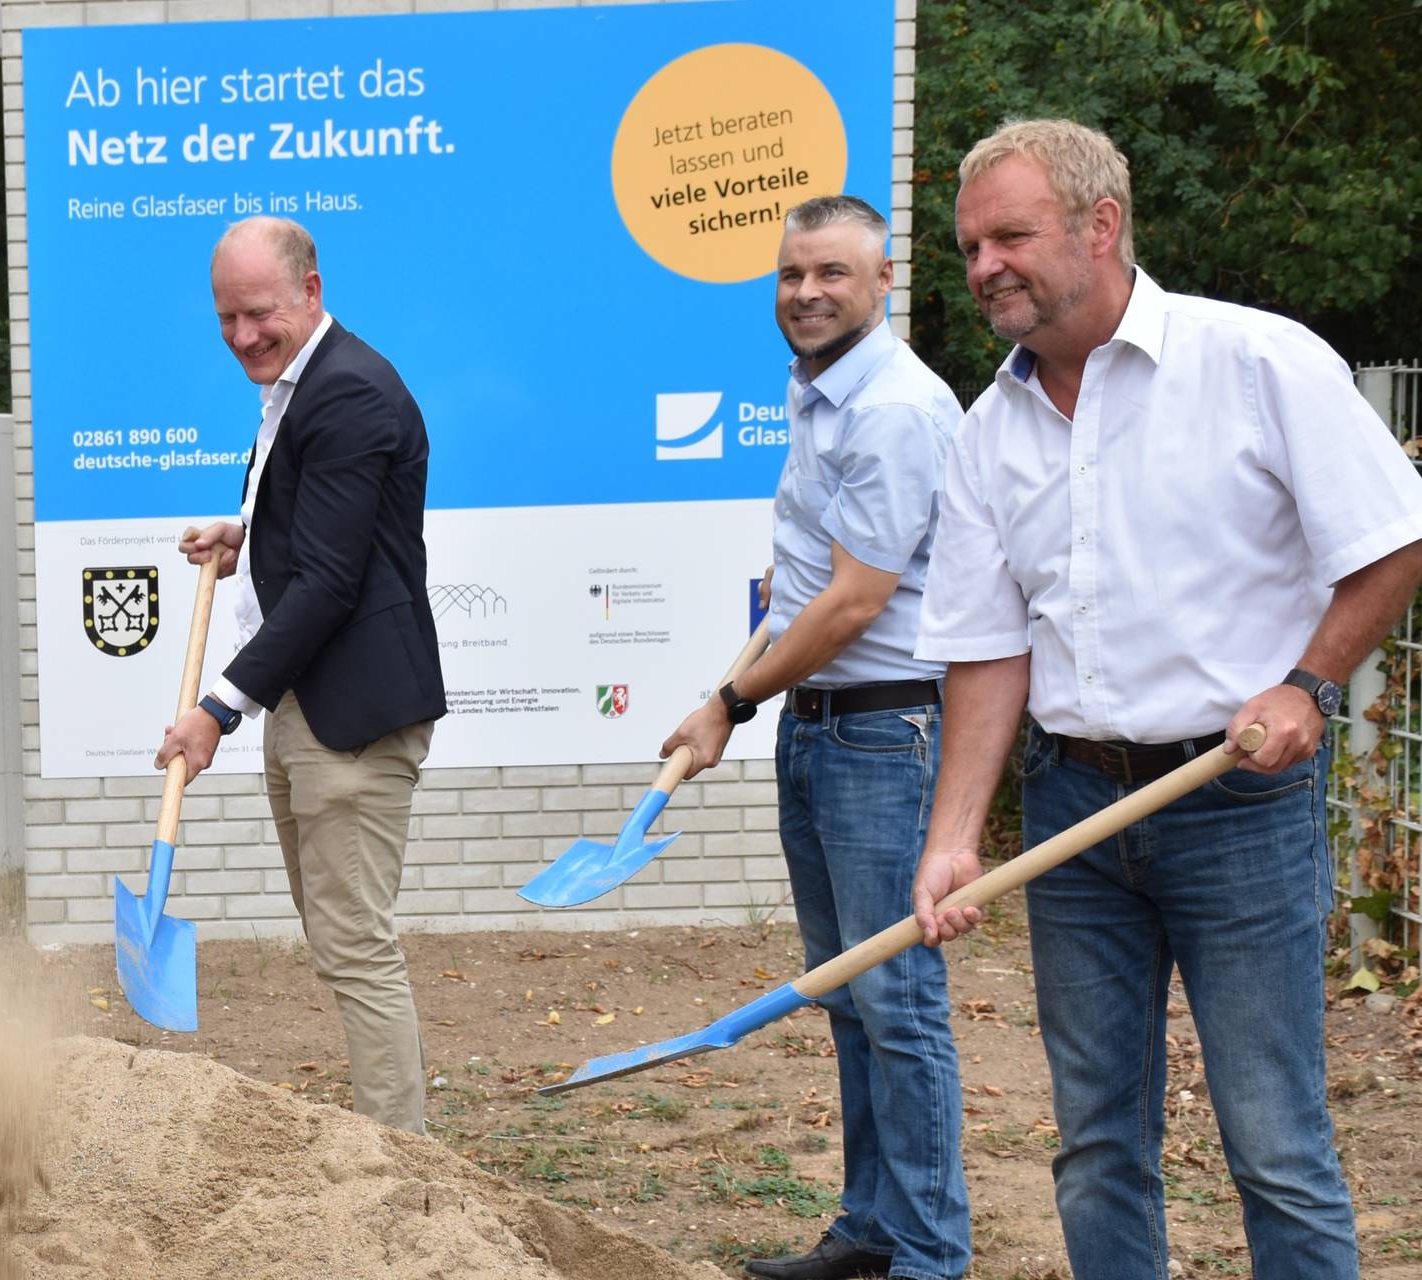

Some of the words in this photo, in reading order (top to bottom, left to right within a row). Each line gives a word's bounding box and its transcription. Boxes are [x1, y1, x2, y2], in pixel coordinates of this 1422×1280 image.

[66, 68, 120, 108] Ab
[137, 66, 207, 106] hier
[220, 65, 345, 104] startet
[359, 58, 425, 98] das
[652, 121, 703, 147] Jetzt
[710, 108, 793, 137] beraten
[68, 128, 168, 166] Netz
[182, 123, 255, 163] der
[269, 115, 455, 160] Zukunft.
[669, 150, 734, 176] lassen
[742, 136, 785, 164] und
[650, 183, 707, 209] viele
[714, 166, 809, 199] Vorteile
[68, 198, 125, 219] Reine
[132, 194, 227, 218] Glasfaser
[234, 192, 263, 214] bis
[270, 191, 298, 213] ins
[306, 190, 363, 212] Haus.
[689, 201, 781, 235] sichern!
[738, 402, 789, 422] Deu
[73, 430, 123, 447] 02861
[129, 428, 161, 446] 890
[165, 427, 198, 444] 600
[738, 425, 792, 446] Glas
[80, 536, 96, 546] Das
[98, 534, 155, 546] Förderprojekt
[156, 535, 176, 544] wird
[462, 638, 508, 648] Breitband
[446, 698, 494, 707] igitalisierung
[496, 697, 510, 705] und
[512, 696, 538, 706] Energie
[487, 688, 497, 696] für
[457, 706, 483, 714] Landes
[485, 704, 559, 714] Nordrhein-Westfalen
